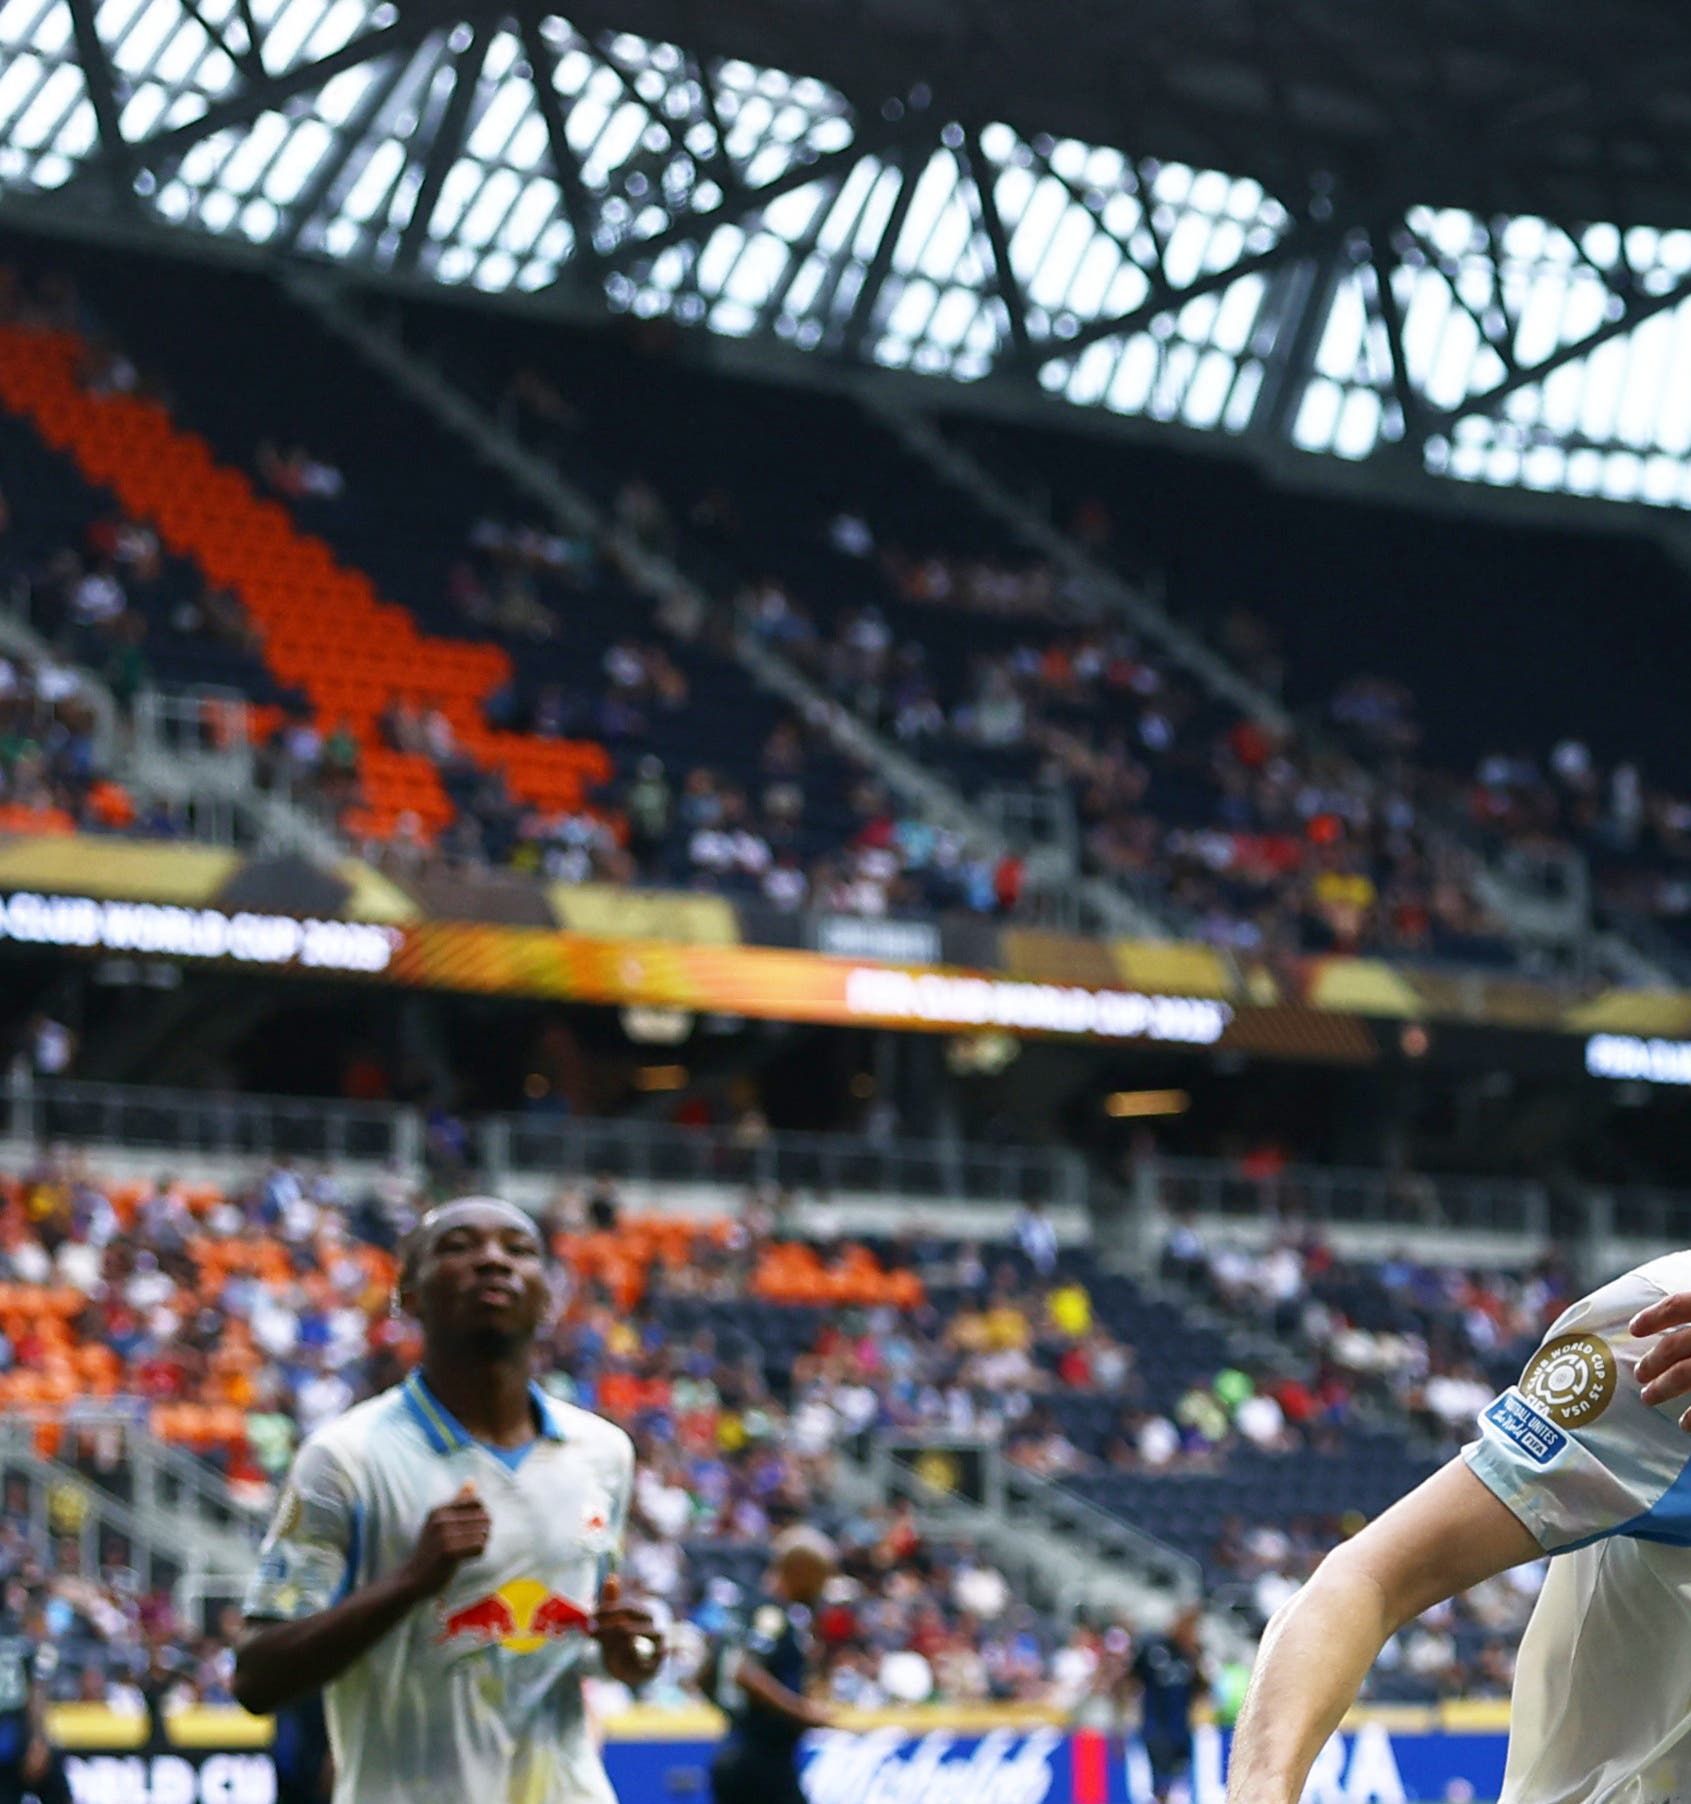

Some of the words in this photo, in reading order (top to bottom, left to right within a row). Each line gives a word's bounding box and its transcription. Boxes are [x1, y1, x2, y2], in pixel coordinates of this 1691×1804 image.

[1551, 1341, 1593, 1359] WORLD
[1591, 1354, 1606, 1379] CUP
[1589, 1383, 1604, 1401] 25
[1561, 1401, 1590, 1418] USA
[1527, 1416, 1559, 1446] UNITES
